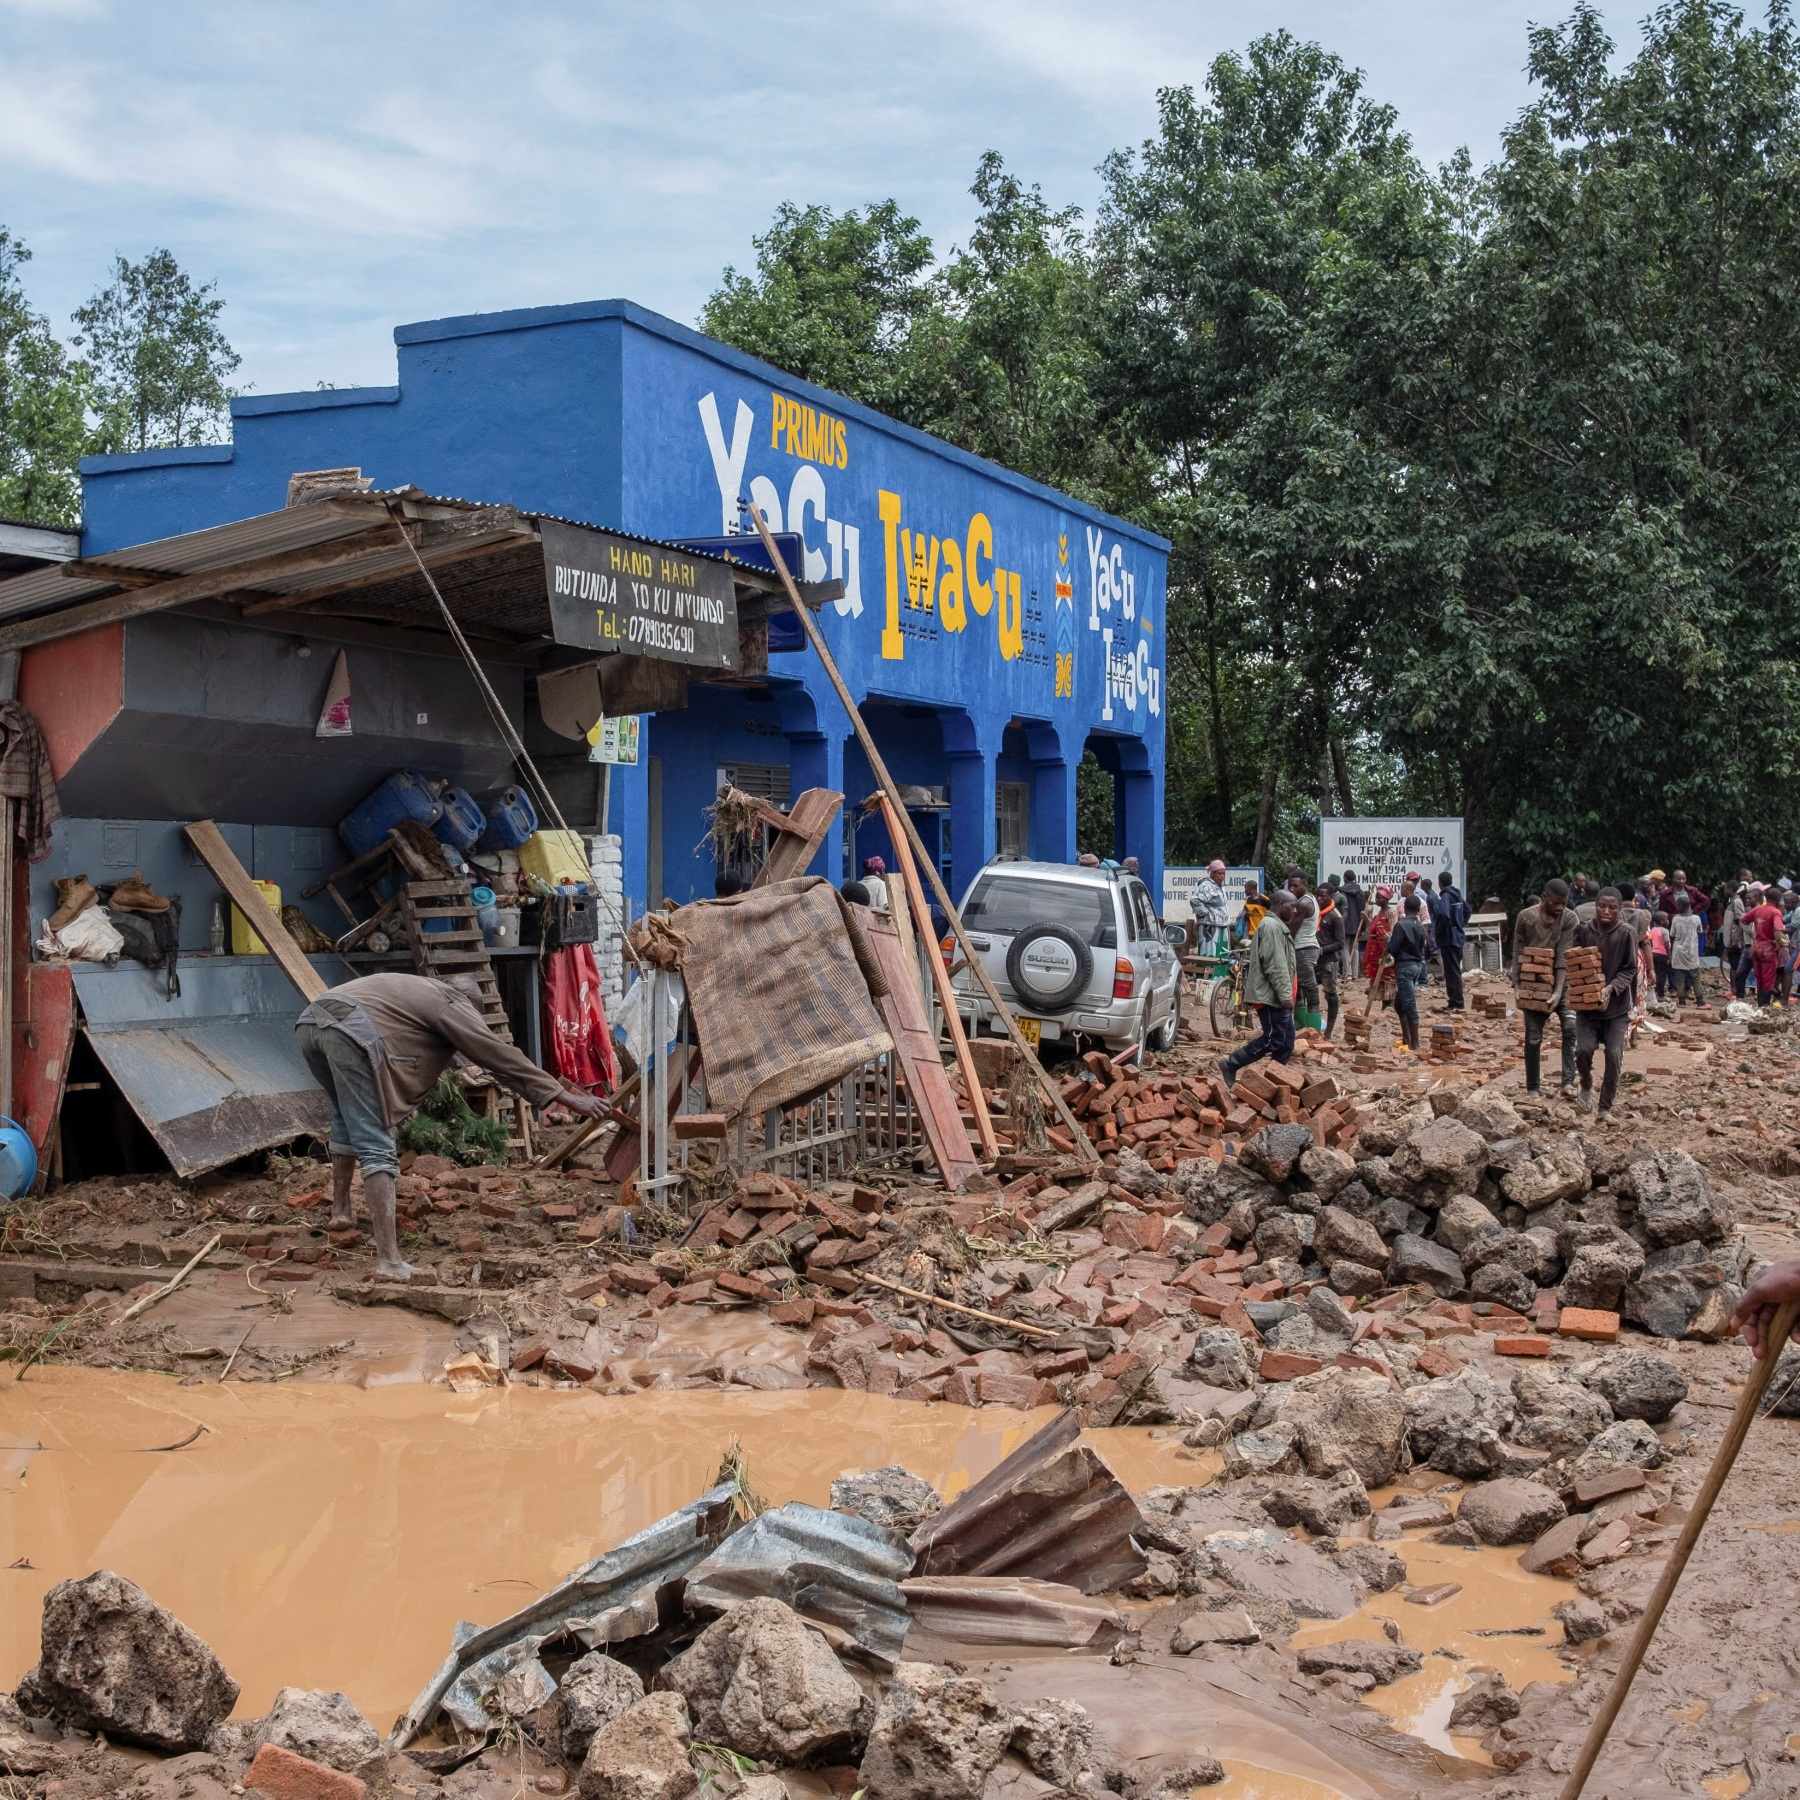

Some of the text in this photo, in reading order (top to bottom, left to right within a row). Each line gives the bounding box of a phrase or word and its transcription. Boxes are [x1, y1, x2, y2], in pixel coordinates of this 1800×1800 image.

[771, 391, 848, 470] PRIMUS
[610, 546, 695, 588] HANO HARI
[555, 565, 724, 625] BUTUNDA YO KU NYUNDO
[1338, 836, 1389, 846] URWIBUTSO
[1359, 846, 1413, 856] JENOSIDE
[1389, 856, 1435, 866] ABATUTSI
[1368, 865, 1407, 875] MU 1994
[1163, 890, 1188, 901] NOTRE
[1027, 954, 1069, 966] SUZUKI
